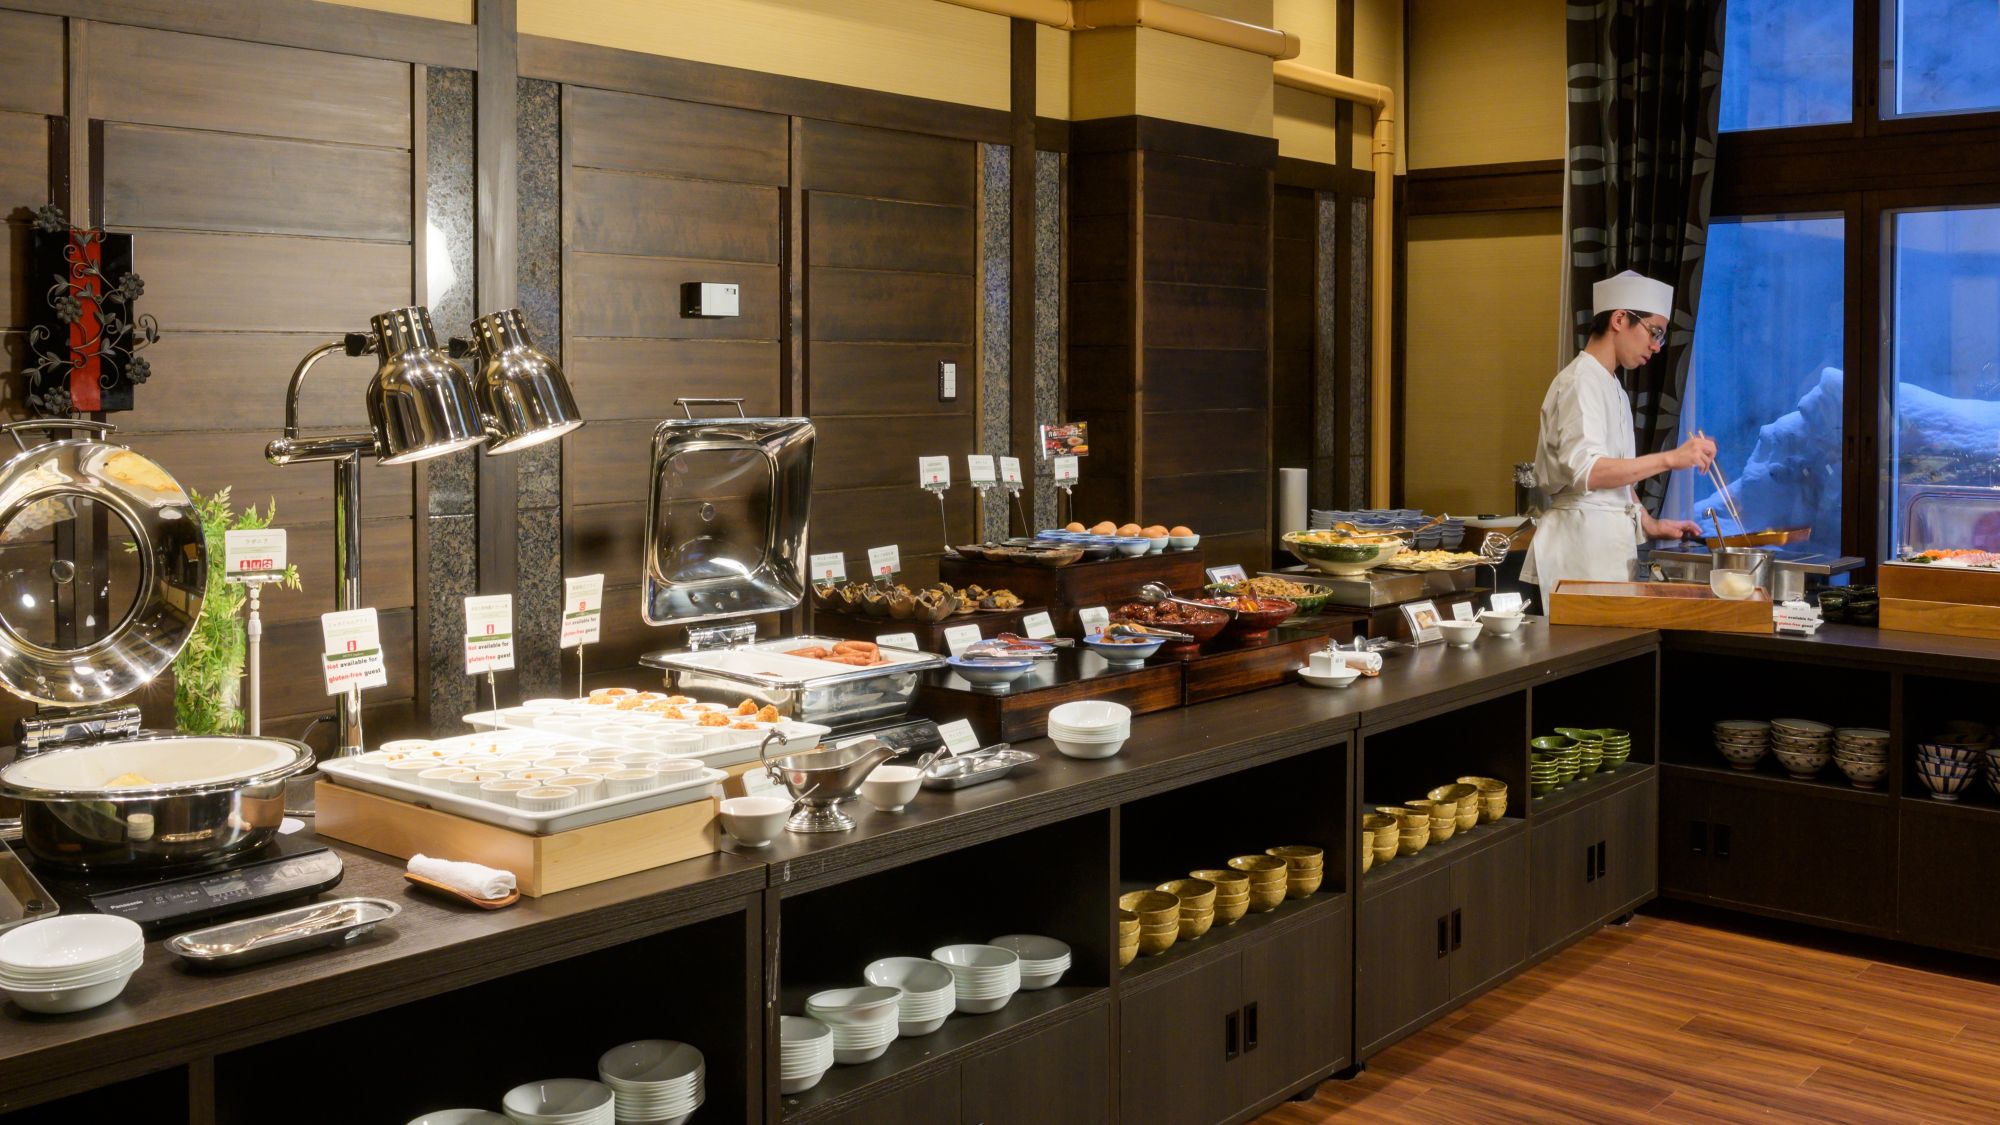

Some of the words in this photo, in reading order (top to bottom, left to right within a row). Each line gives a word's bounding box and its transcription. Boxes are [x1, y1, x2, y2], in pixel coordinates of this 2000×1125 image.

[478, 642, 501, 650] available
[326, 662, 339, 670] Not
[340, 658, 367, 668] available
[468, 655, 496, 664] gluten-free
[497, 652, 511, 660] guest
[328, 672, 363, 684] gluten-free
[364, 668, 381, 677] guest
[110, 900, 144, 910] Panasonic
